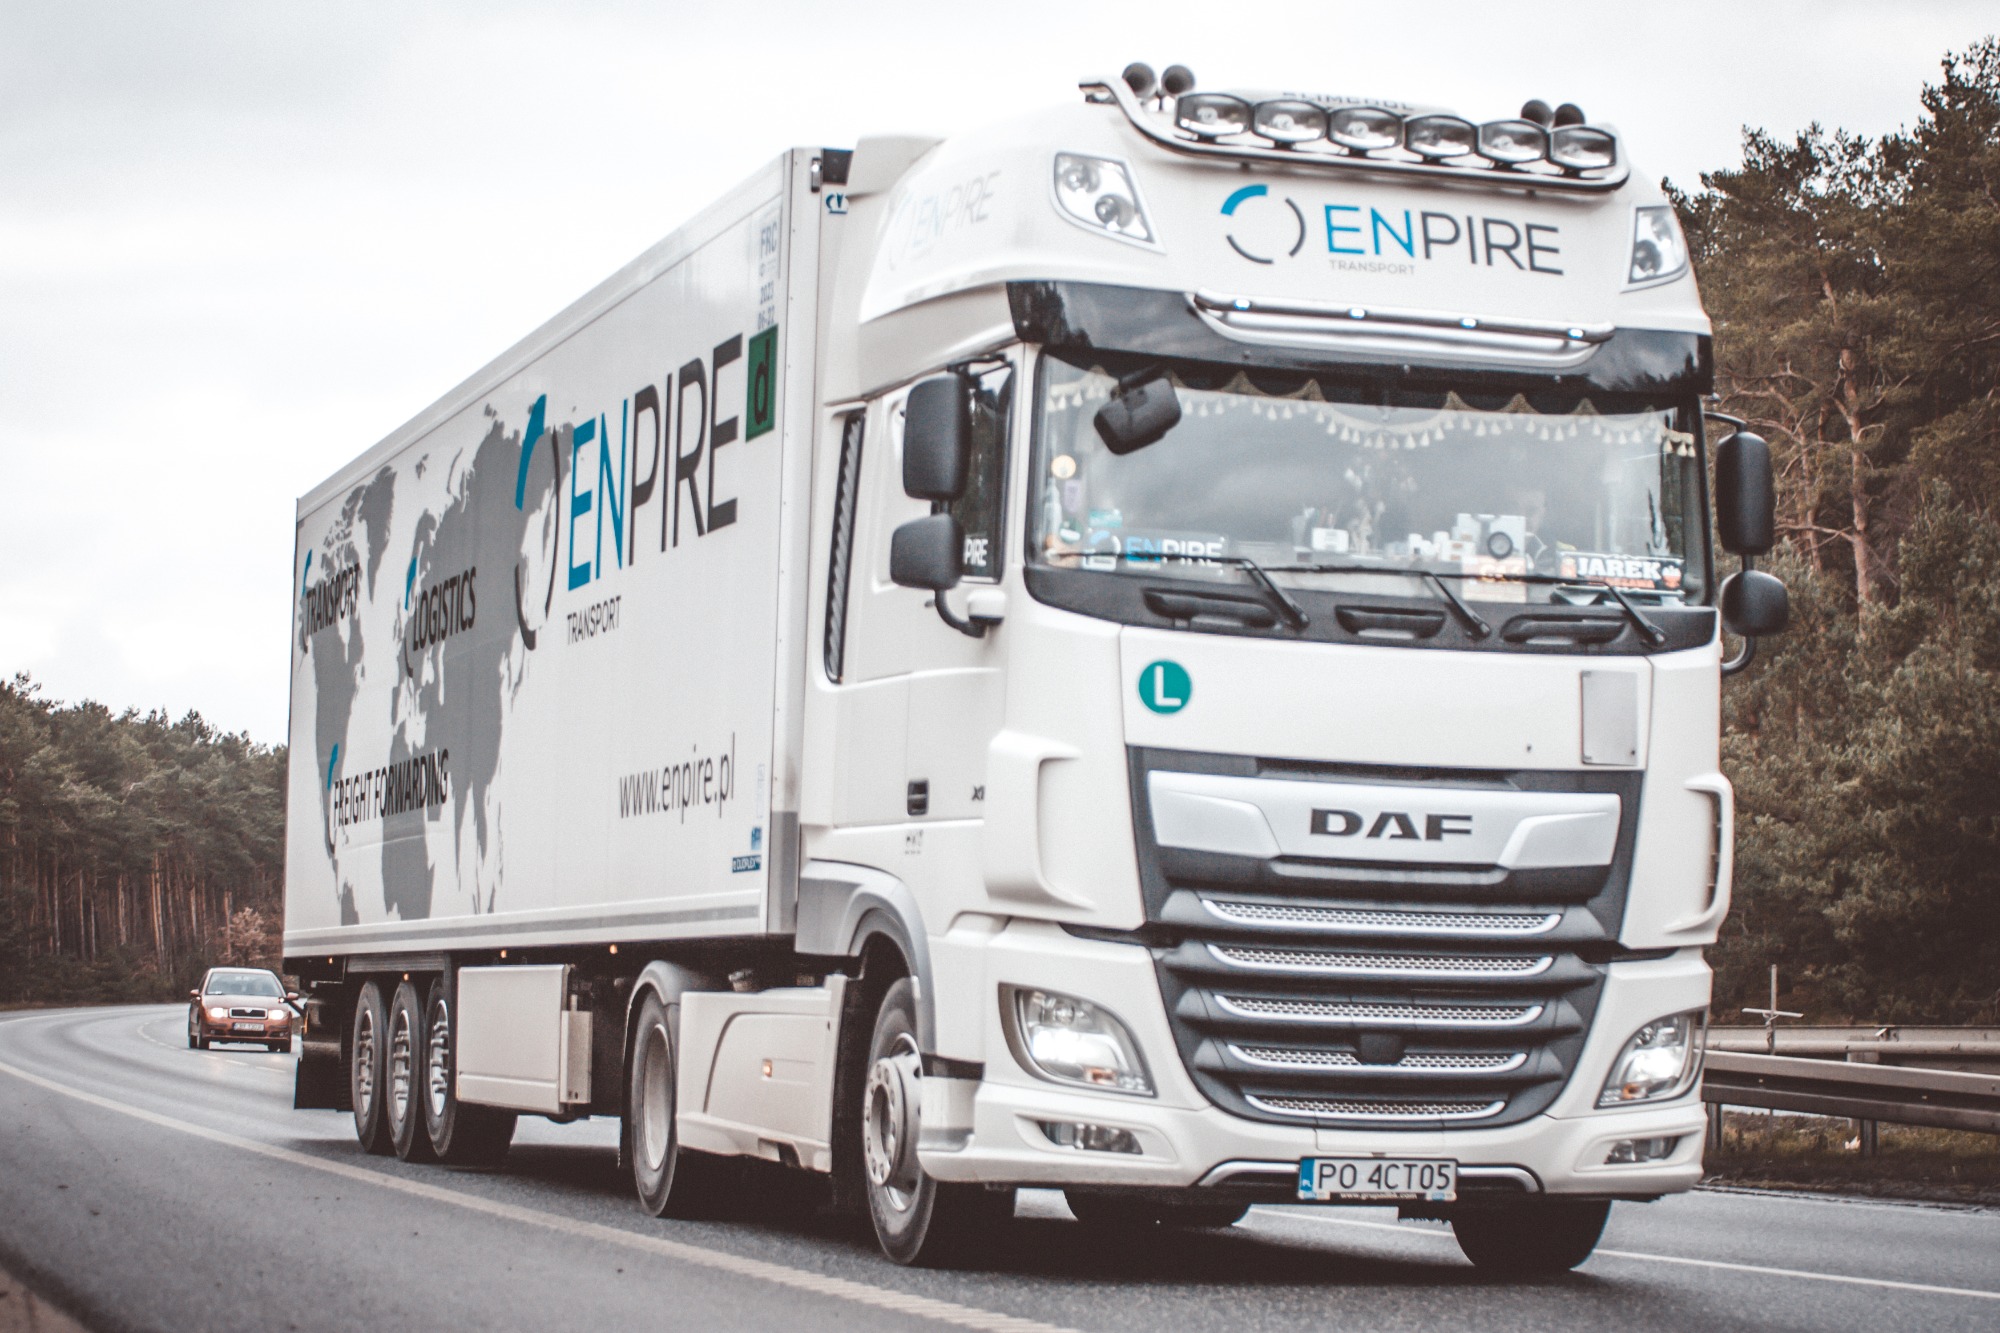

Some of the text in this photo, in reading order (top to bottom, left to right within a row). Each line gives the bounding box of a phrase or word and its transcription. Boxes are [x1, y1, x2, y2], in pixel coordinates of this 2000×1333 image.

[1324, 204, 1564, 276] ENPIRE
[1329, 259, 1415, 276] TRANSPORT
[755, 338, 770, 426] d
[568, 332, 744, 592] ENPIRE
[1125, 536, 1223, 568] ENPIRE
[1578, 557, 1662, 581] JAREK
[306, 562, 361, 636] TRANSPORT
[413, 566, 477, 651] LOGISTICS
[567, 595, 622, 646] TRANSPORT
[1155, 665, 1182, 707] L
[334, 748, 449, 828] FREIGHT FORWARDING
[619, 731, 736, 825] www.enpire.pl
[1309, 808, 1473, 841] DAF
[1318, 1163, 1451, 1190] PO 4CT05
